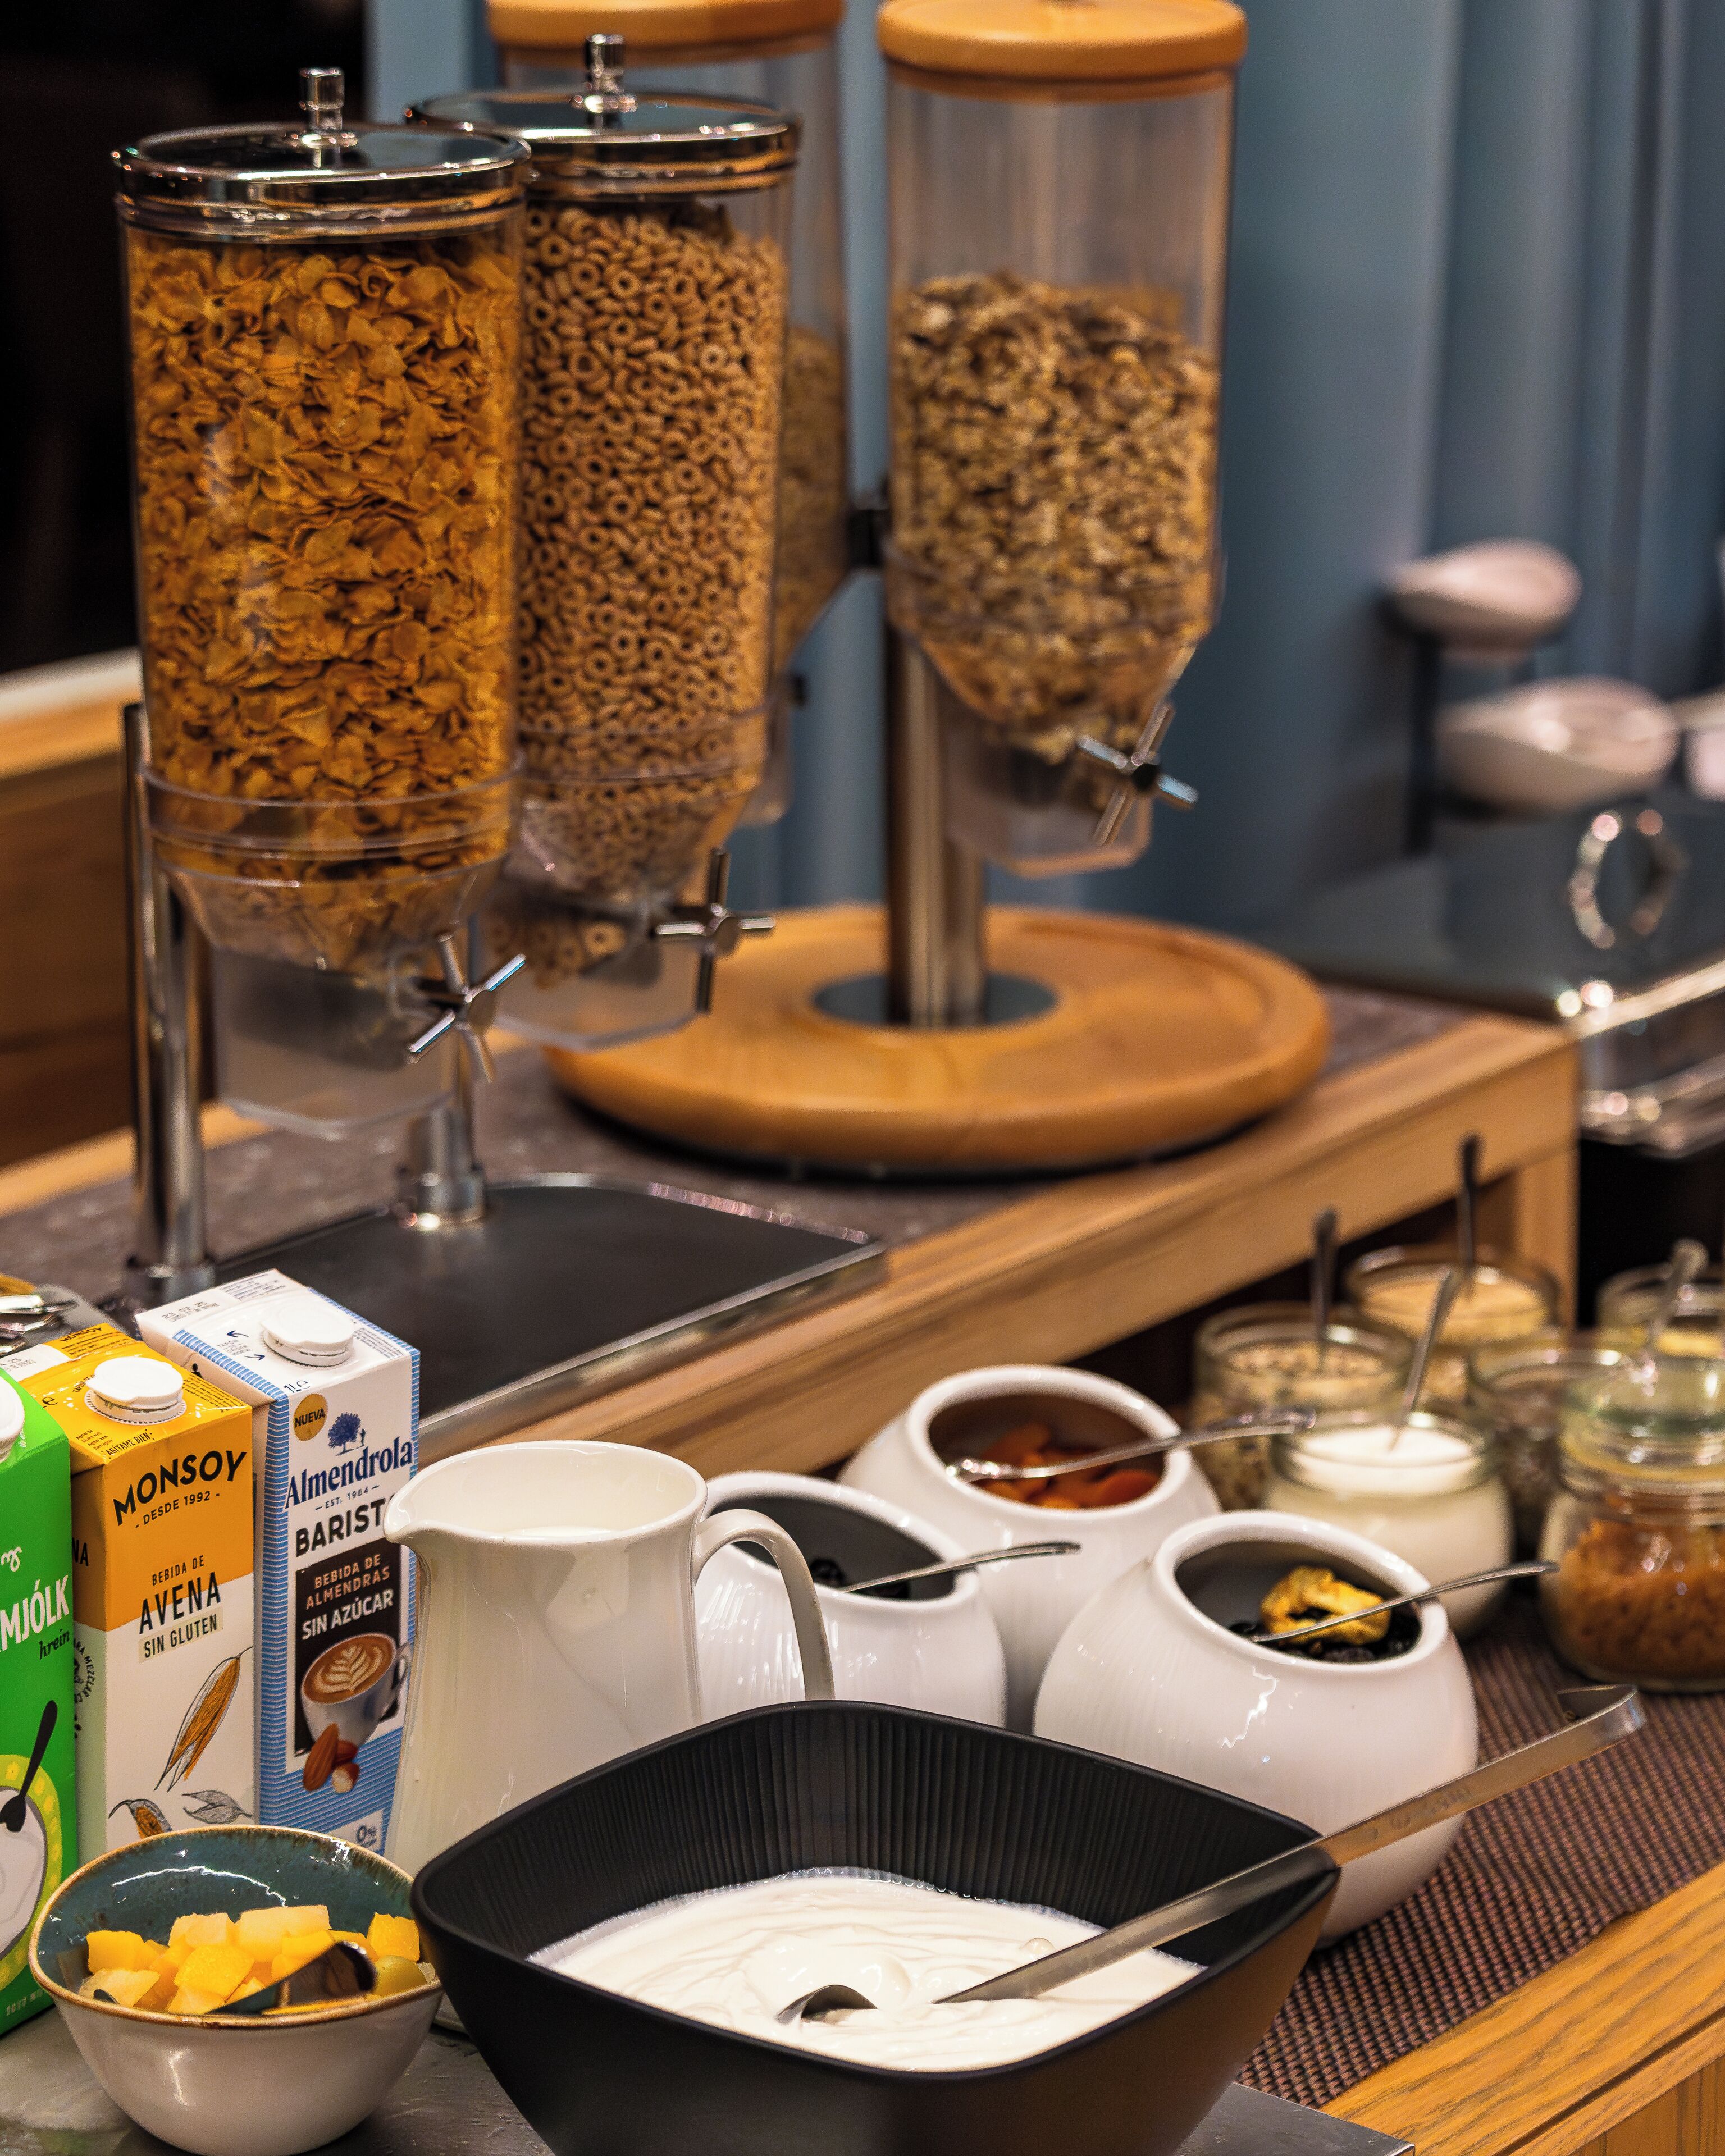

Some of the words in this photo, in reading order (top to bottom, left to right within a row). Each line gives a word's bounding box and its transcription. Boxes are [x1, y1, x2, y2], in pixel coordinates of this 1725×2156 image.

[294, 1408, 325, 1428] NUEVA
[106, 1439, 136, 1456] AGÍTAME
[134, 1432, 151, 1444] BIEN
[113, 1450, 248, 1526] MONSOY
[285, 1436, 413, 1509] Almendrola
[143, 1499, 179, 1525] DESDE
[184, 1491, 211, 1506] 1992
[296, 1495, 394, 1557] BARIST
[152, 1562, 187, 1586] BEBIDA
[193, 1555, 204, 1569] DE
[306, 1566, 390, 1610] ALMENDRAS
[314, 1562, 360, 1589] BEBIDA
[365, 1554, 381, 1570] DE
[0, 1574, 70, 1652] MJÓLK
[139, 1572, 221, 1635] AVENA
[302, 1614, 327, 1640] SIN
[331, 1588, 393, 1629] AZÚCAR
[144, 1634, 165, 1658] SIN
[170, 1614, 217, 1647] GLUTEN
